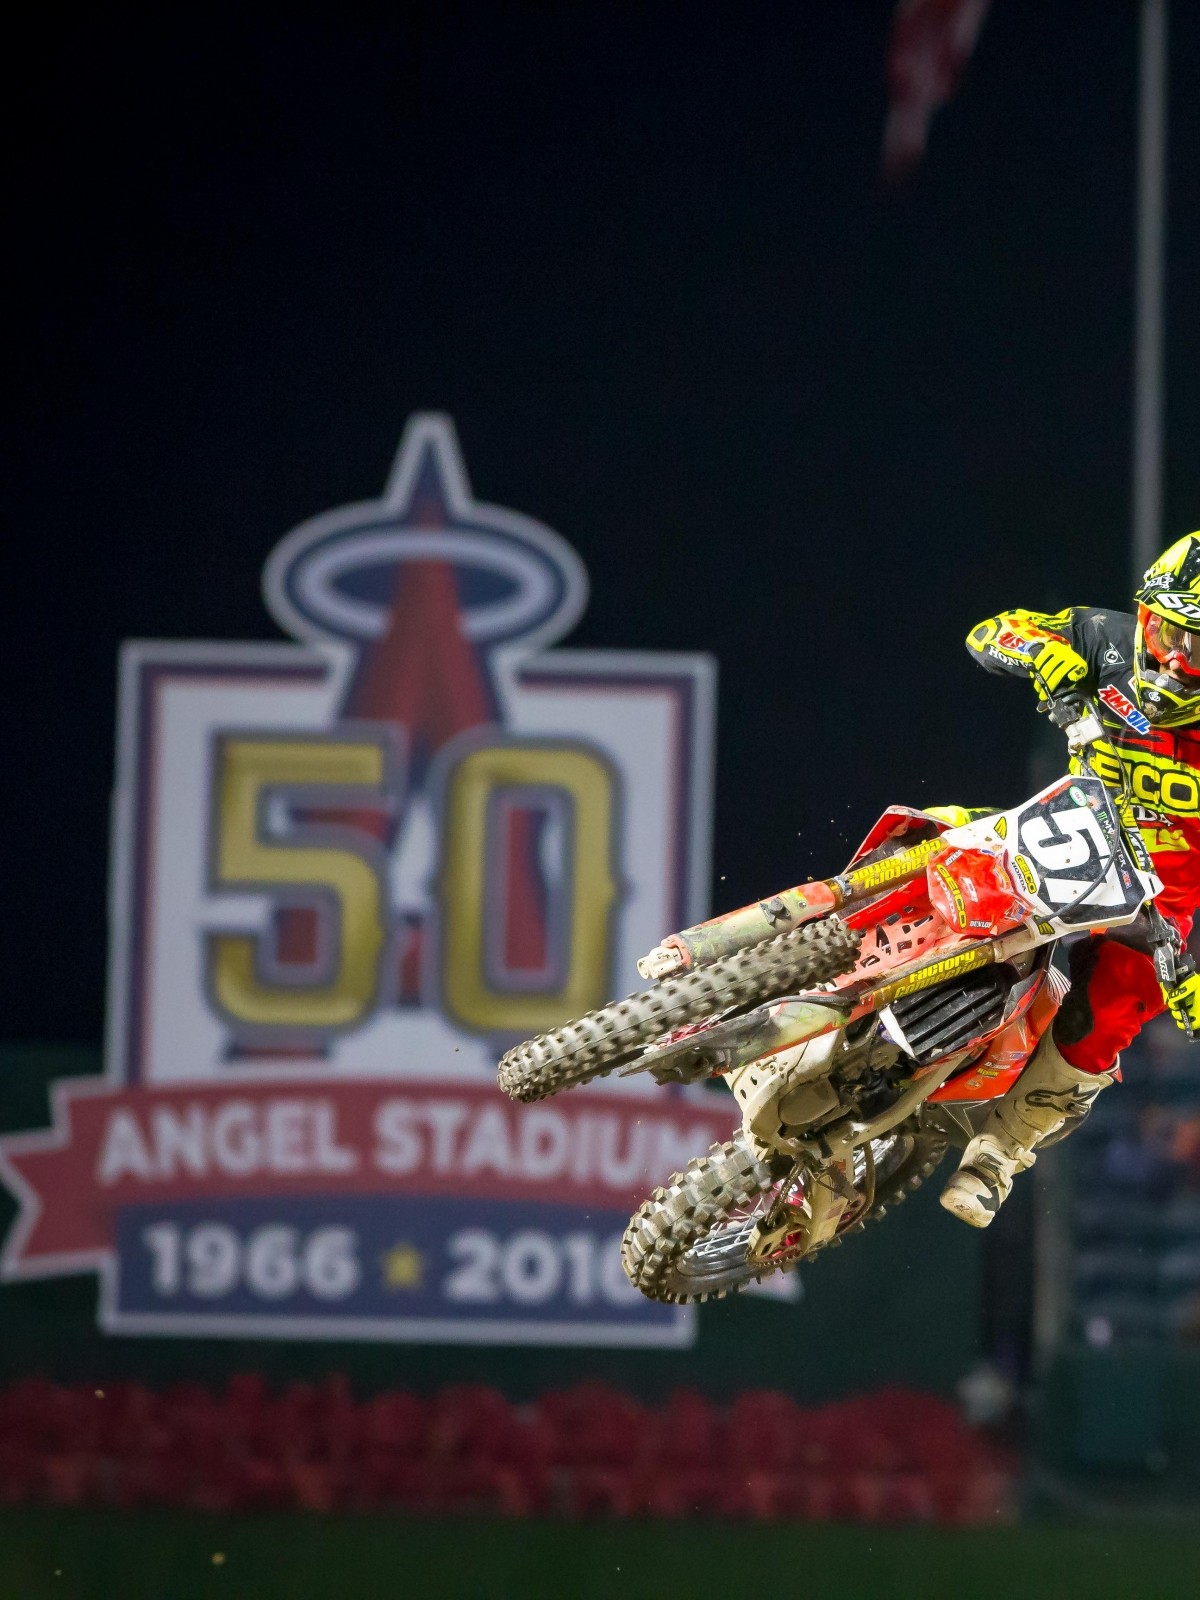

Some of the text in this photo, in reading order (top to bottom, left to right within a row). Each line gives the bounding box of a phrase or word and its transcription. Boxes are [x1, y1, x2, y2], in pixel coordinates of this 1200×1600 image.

[1098, 684, 1151, 735] AMSOIL
[1090, 752, 1200, 812] EICO
[208, 729, 620, 1034] 50
[1011, 861, 1027, 892] HONDA
[1014, 854, 1038, 895] GEICO
[1021, 805, 1127, 907] 57
[936, 863, 967, 929] GEICO
[98, 1100, 716, 1190] ANGEL STADIUM
[143, 1221, 362, 1297] 1966
